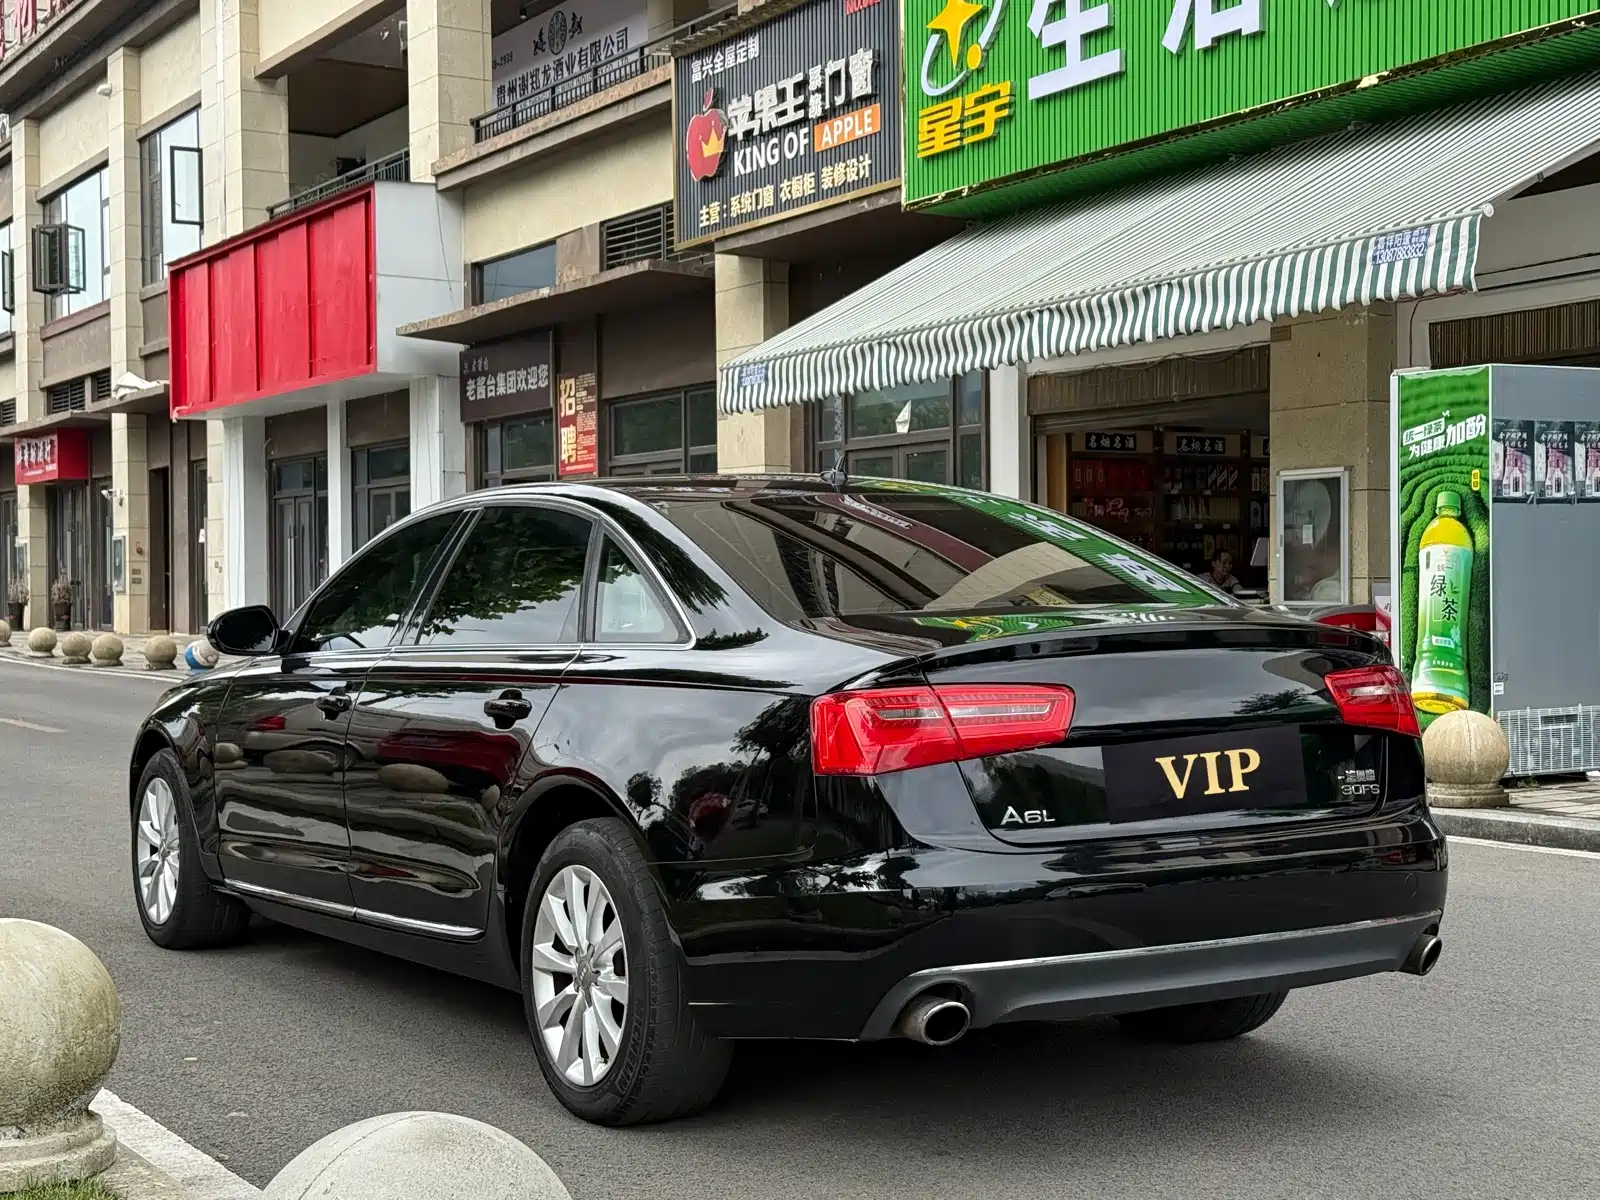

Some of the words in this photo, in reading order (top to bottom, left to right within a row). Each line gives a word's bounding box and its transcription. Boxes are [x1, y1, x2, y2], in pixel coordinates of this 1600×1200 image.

[496, 26, 629, 107] 贵州谢郑龙酒业有限公司
[691, 34, 760, 84] 富兴全屋定制
[734, 137, 780, 177] KING
[784, 127, 809, 160] OF
[821, 109, 874, 148] APPLE
[917, 80, 1011, 159] 星宇
[821, 153, 872, 190] 装修设计
[466, 363, 549, 402] 老酱台集团欢迎您
[560, 377, 577, 464] 招聘
[1430, 574, 1458, 622] 绿茶
[1155, 748, 1261, 799] VIP
[1000, 805, 1056, 826] A6L
